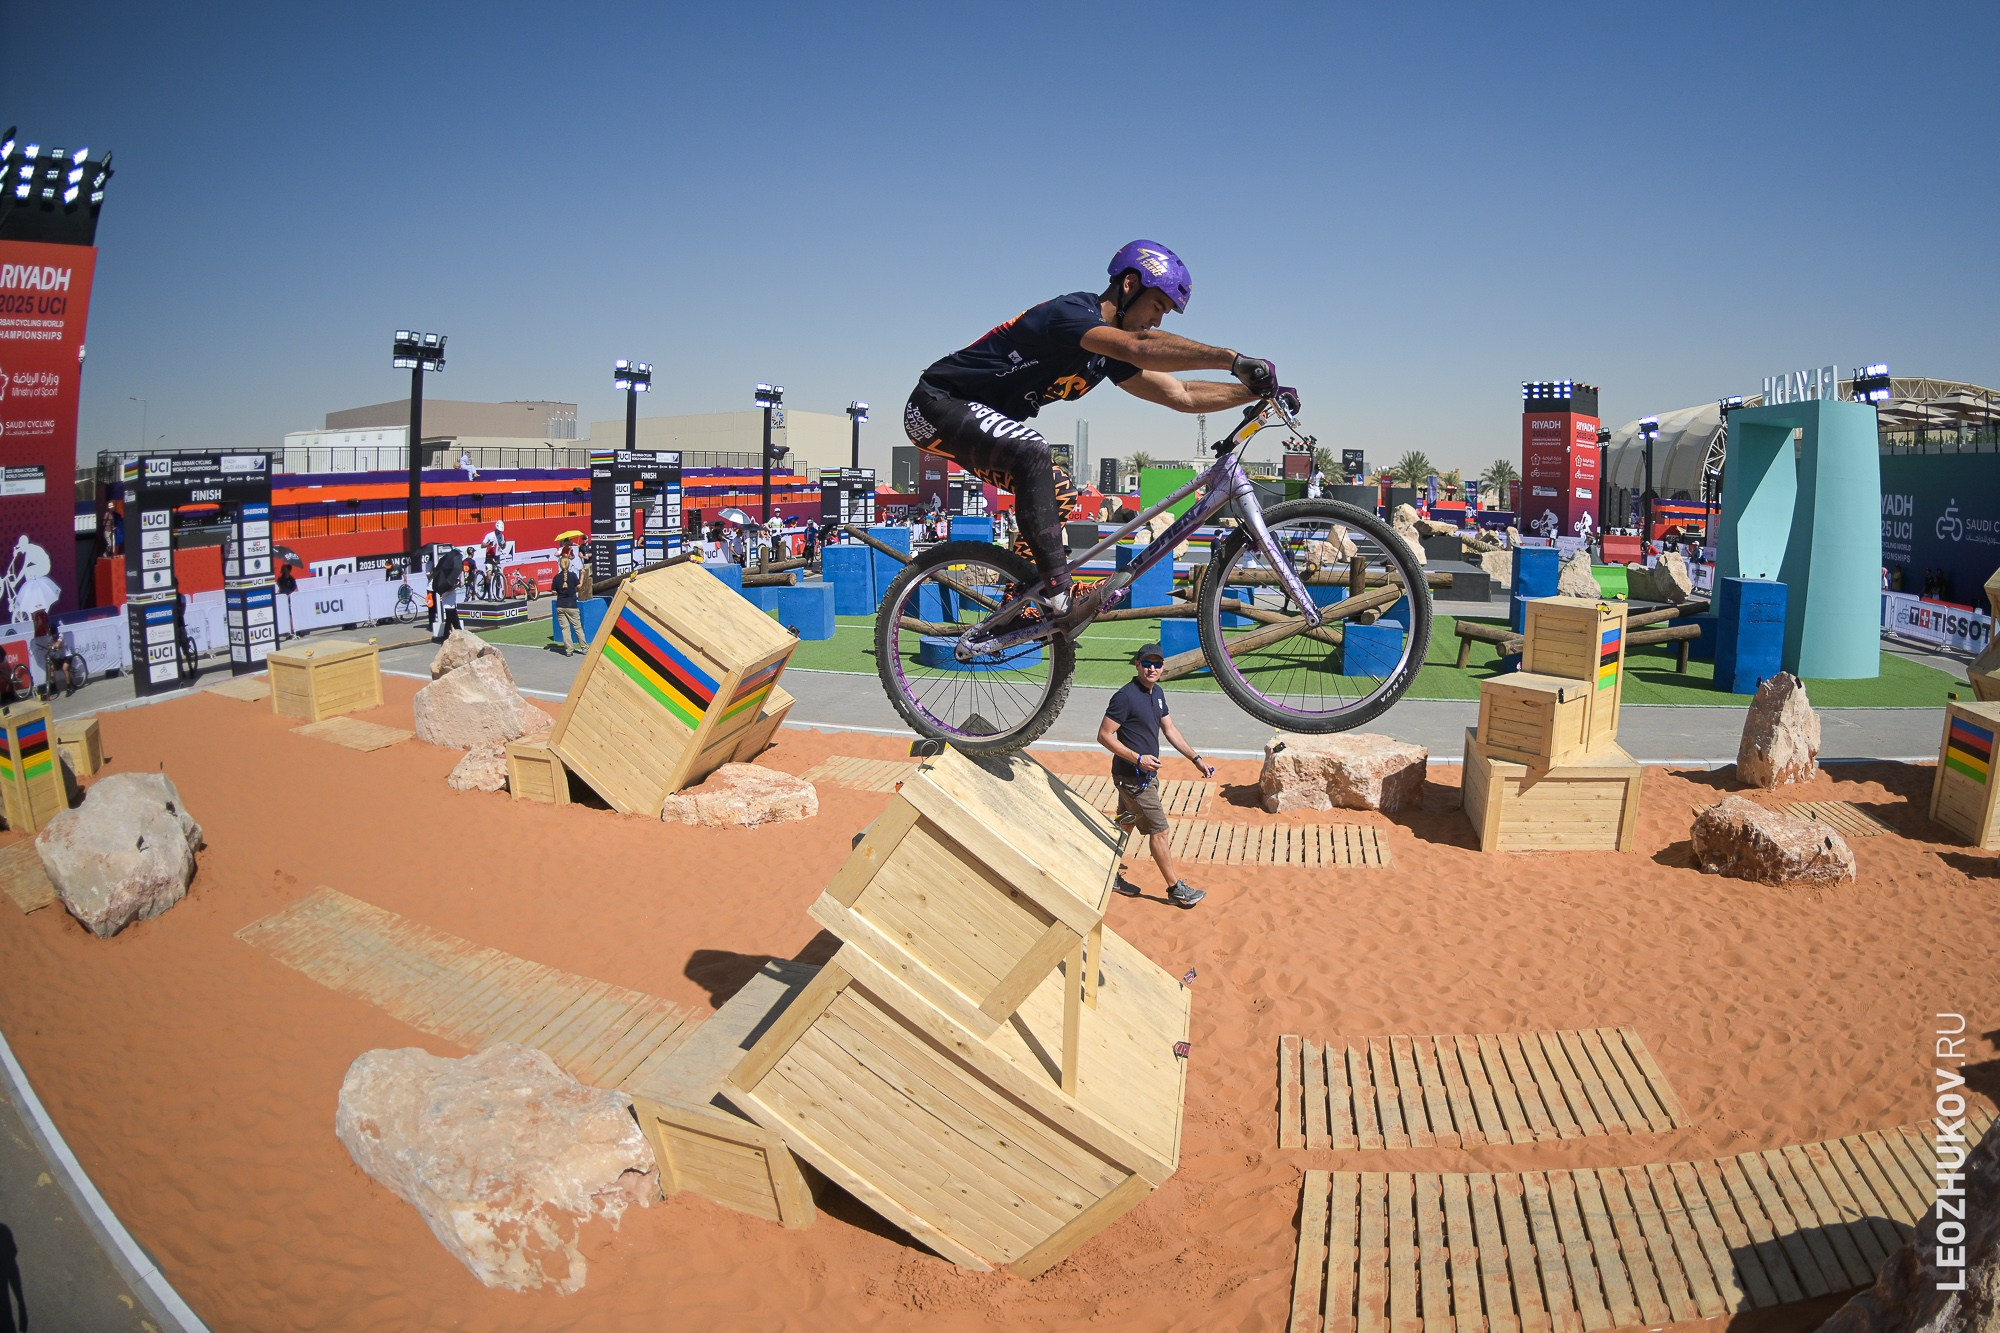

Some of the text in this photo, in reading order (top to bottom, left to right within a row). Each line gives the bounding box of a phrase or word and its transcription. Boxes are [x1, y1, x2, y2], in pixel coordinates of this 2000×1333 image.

[0, 264, 72, 292] RIYADH
[0, 294, 67, 315] 2025 UCI
[15, 319, 41, 327] CYCLING
[42, 320, 64, 328] WORLD
[13, 372, 59, 386] وزارة الرياضة
[12, 387, 58, 397] Ministry of Sport
[5, 419, 55, 429] SAUDI CYCLING
[912, 406, 938, 435] SCHOOL
[1532, 420, 1560, 429] RIYADH
[1576, 421, 1596, 432] RIYADH
[620, 452, 630, 461] UCI
[150, 462, 169, 474] UCI
[642, 472, 657, 480] FINISH
[618, 485, 629, 493] UCI
[191, 489, 222, 501] FINISH
[890, 506, 907, 514] UCI
[148, 514, 166, 526] UCI
[1966, 518, 1992, 532] SAUDI
[1894, 521, 1912, 540] UCI
[146, 558, 166, 566] TISSOT
[359, 560, 376, 570] 2025
[246, 594, 272, 603] SHIMANO
[320, 598, 344, 614] UCI
[146, 610, 172, 620] SHIMANO
[505, 608, 518, 618] UCI
[254, 627, 272, 640] UCI
[1932, 613, 1991, 644] TISSOT
[154, 646, 172, 660] UCI
[1380, 668, 1408, 702] KENDA
